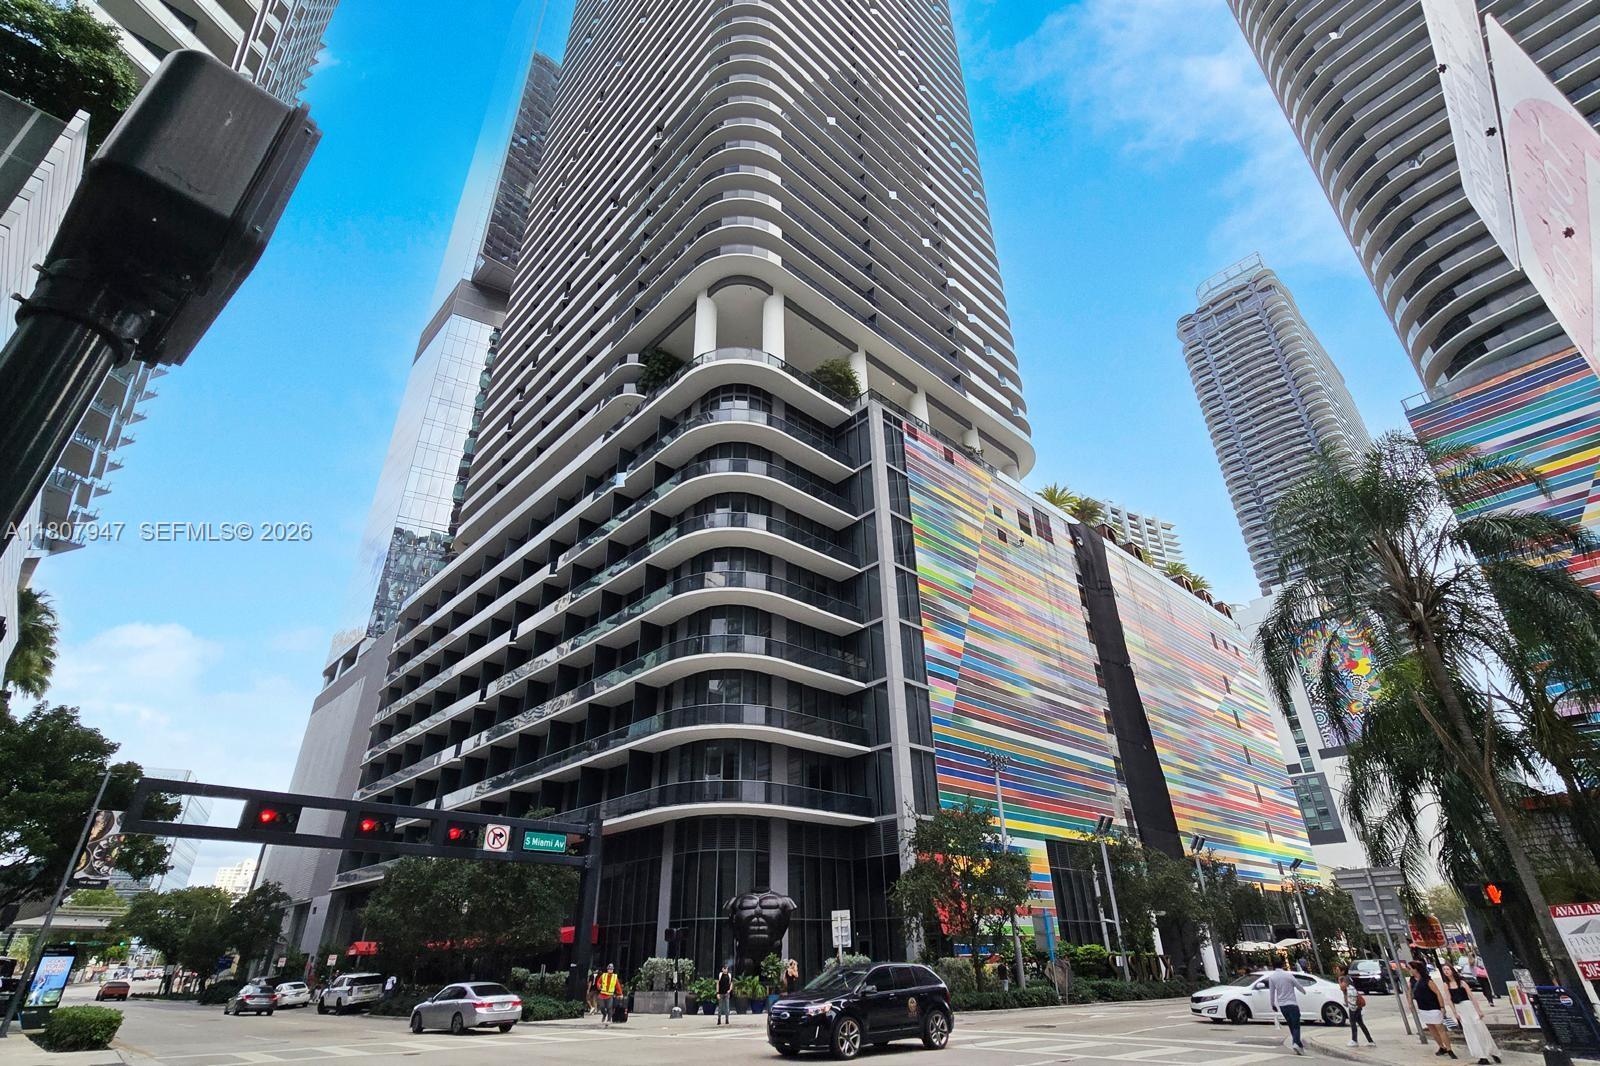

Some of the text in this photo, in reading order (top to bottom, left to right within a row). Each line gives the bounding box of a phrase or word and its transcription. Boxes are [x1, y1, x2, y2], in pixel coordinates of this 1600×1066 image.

[525, 837, 565, 848] S Miami Av
[1556, 903, 1600, 916] AVAILAB
